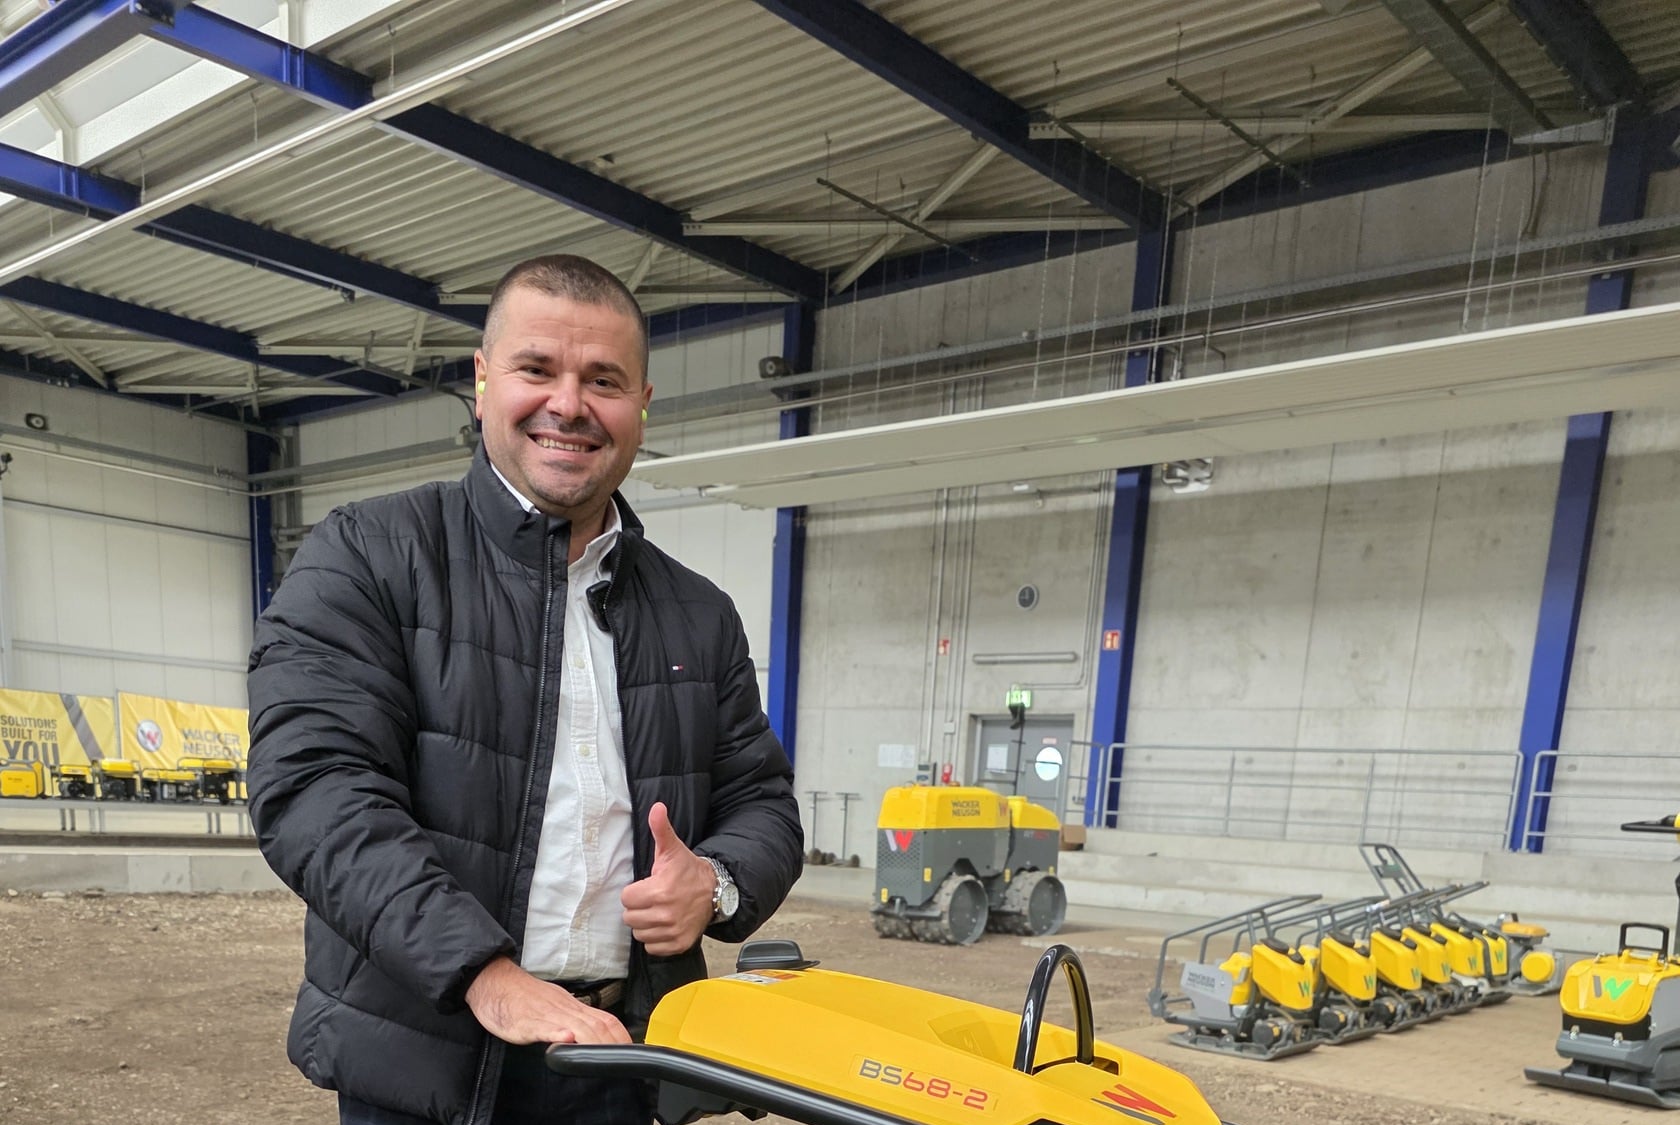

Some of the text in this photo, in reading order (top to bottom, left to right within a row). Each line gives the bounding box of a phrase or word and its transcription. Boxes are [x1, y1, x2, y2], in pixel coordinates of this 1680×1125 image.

[0, 714, 57, 729] SOLUTIONS
[1, 727, 57, 742] BUILT FOR
[3, 739, 60, 769] YOU
[859, 1058, 988, 1111] BS68-2
